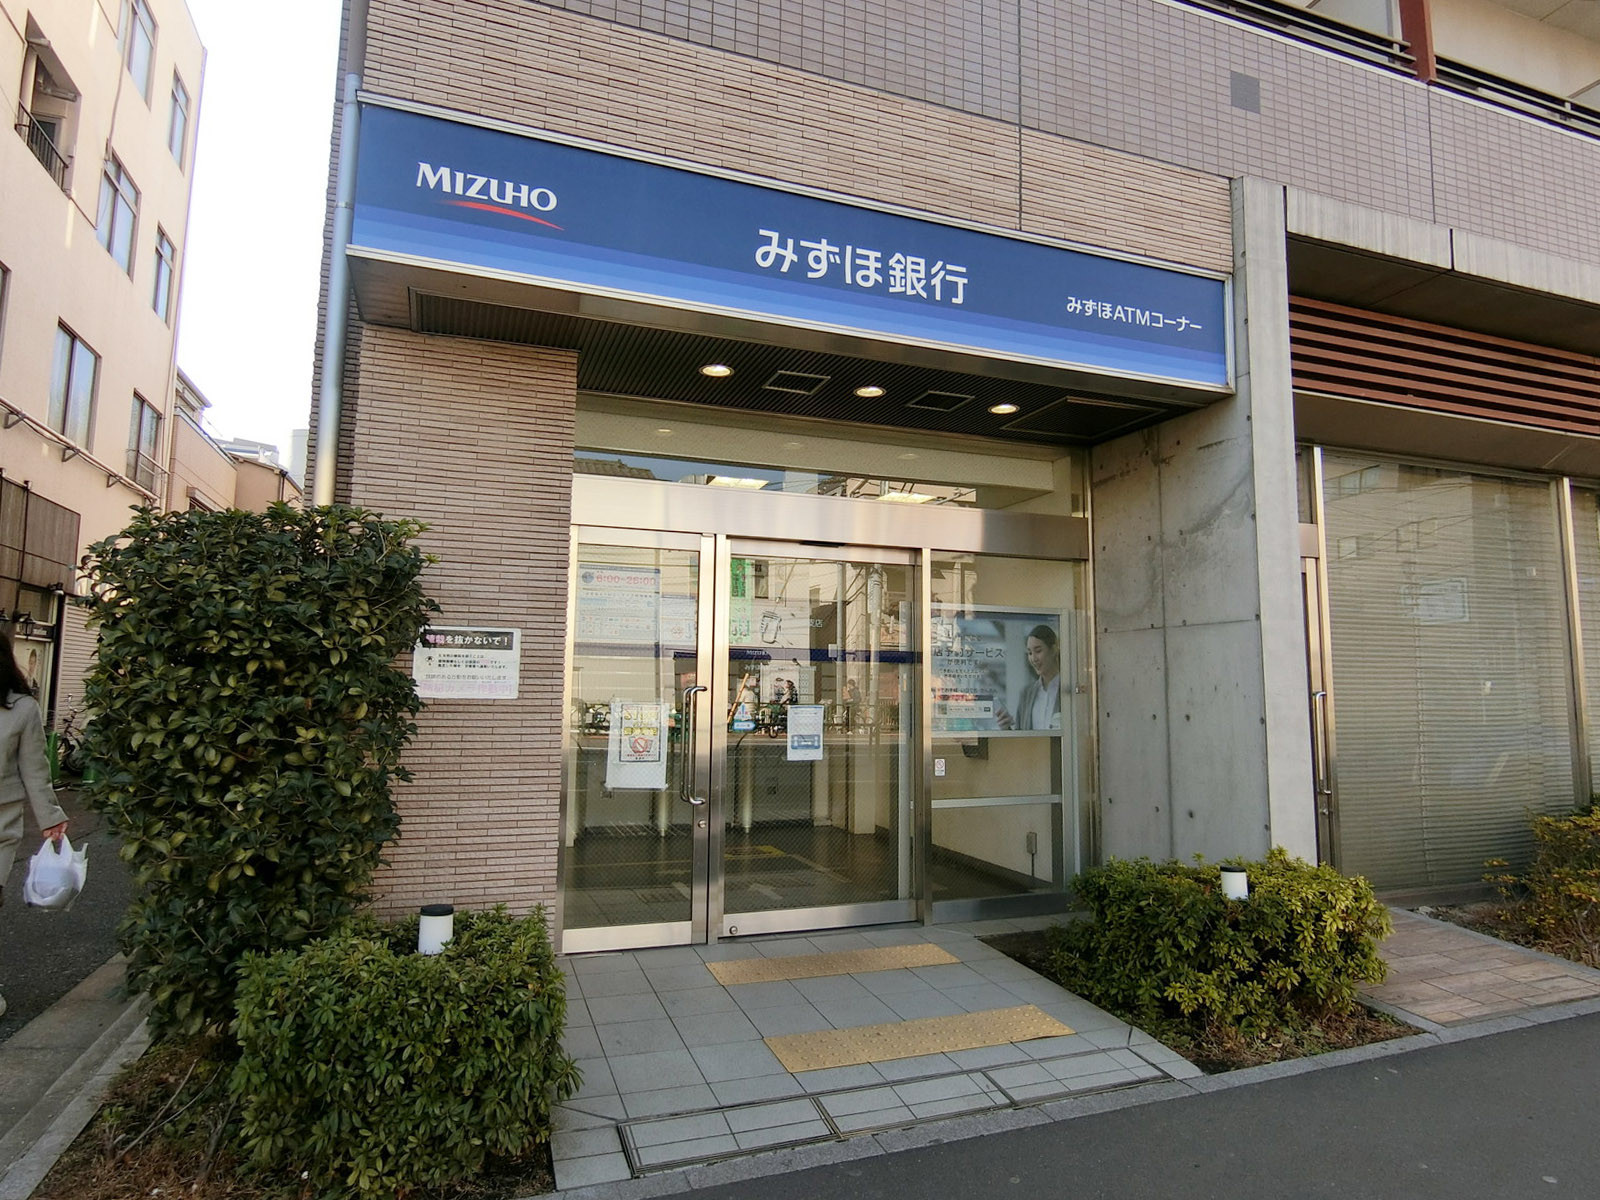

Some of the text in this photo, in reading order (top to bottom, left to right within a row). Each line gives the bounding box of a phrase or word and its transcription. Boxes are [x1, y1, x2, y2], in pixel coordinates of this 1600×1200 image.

[416, 162, 557, 211] MIZUHO
[754, 229, 968, 304] みずほ銀行
[1066, 296, 1202, 332] みずほATMコーナー
